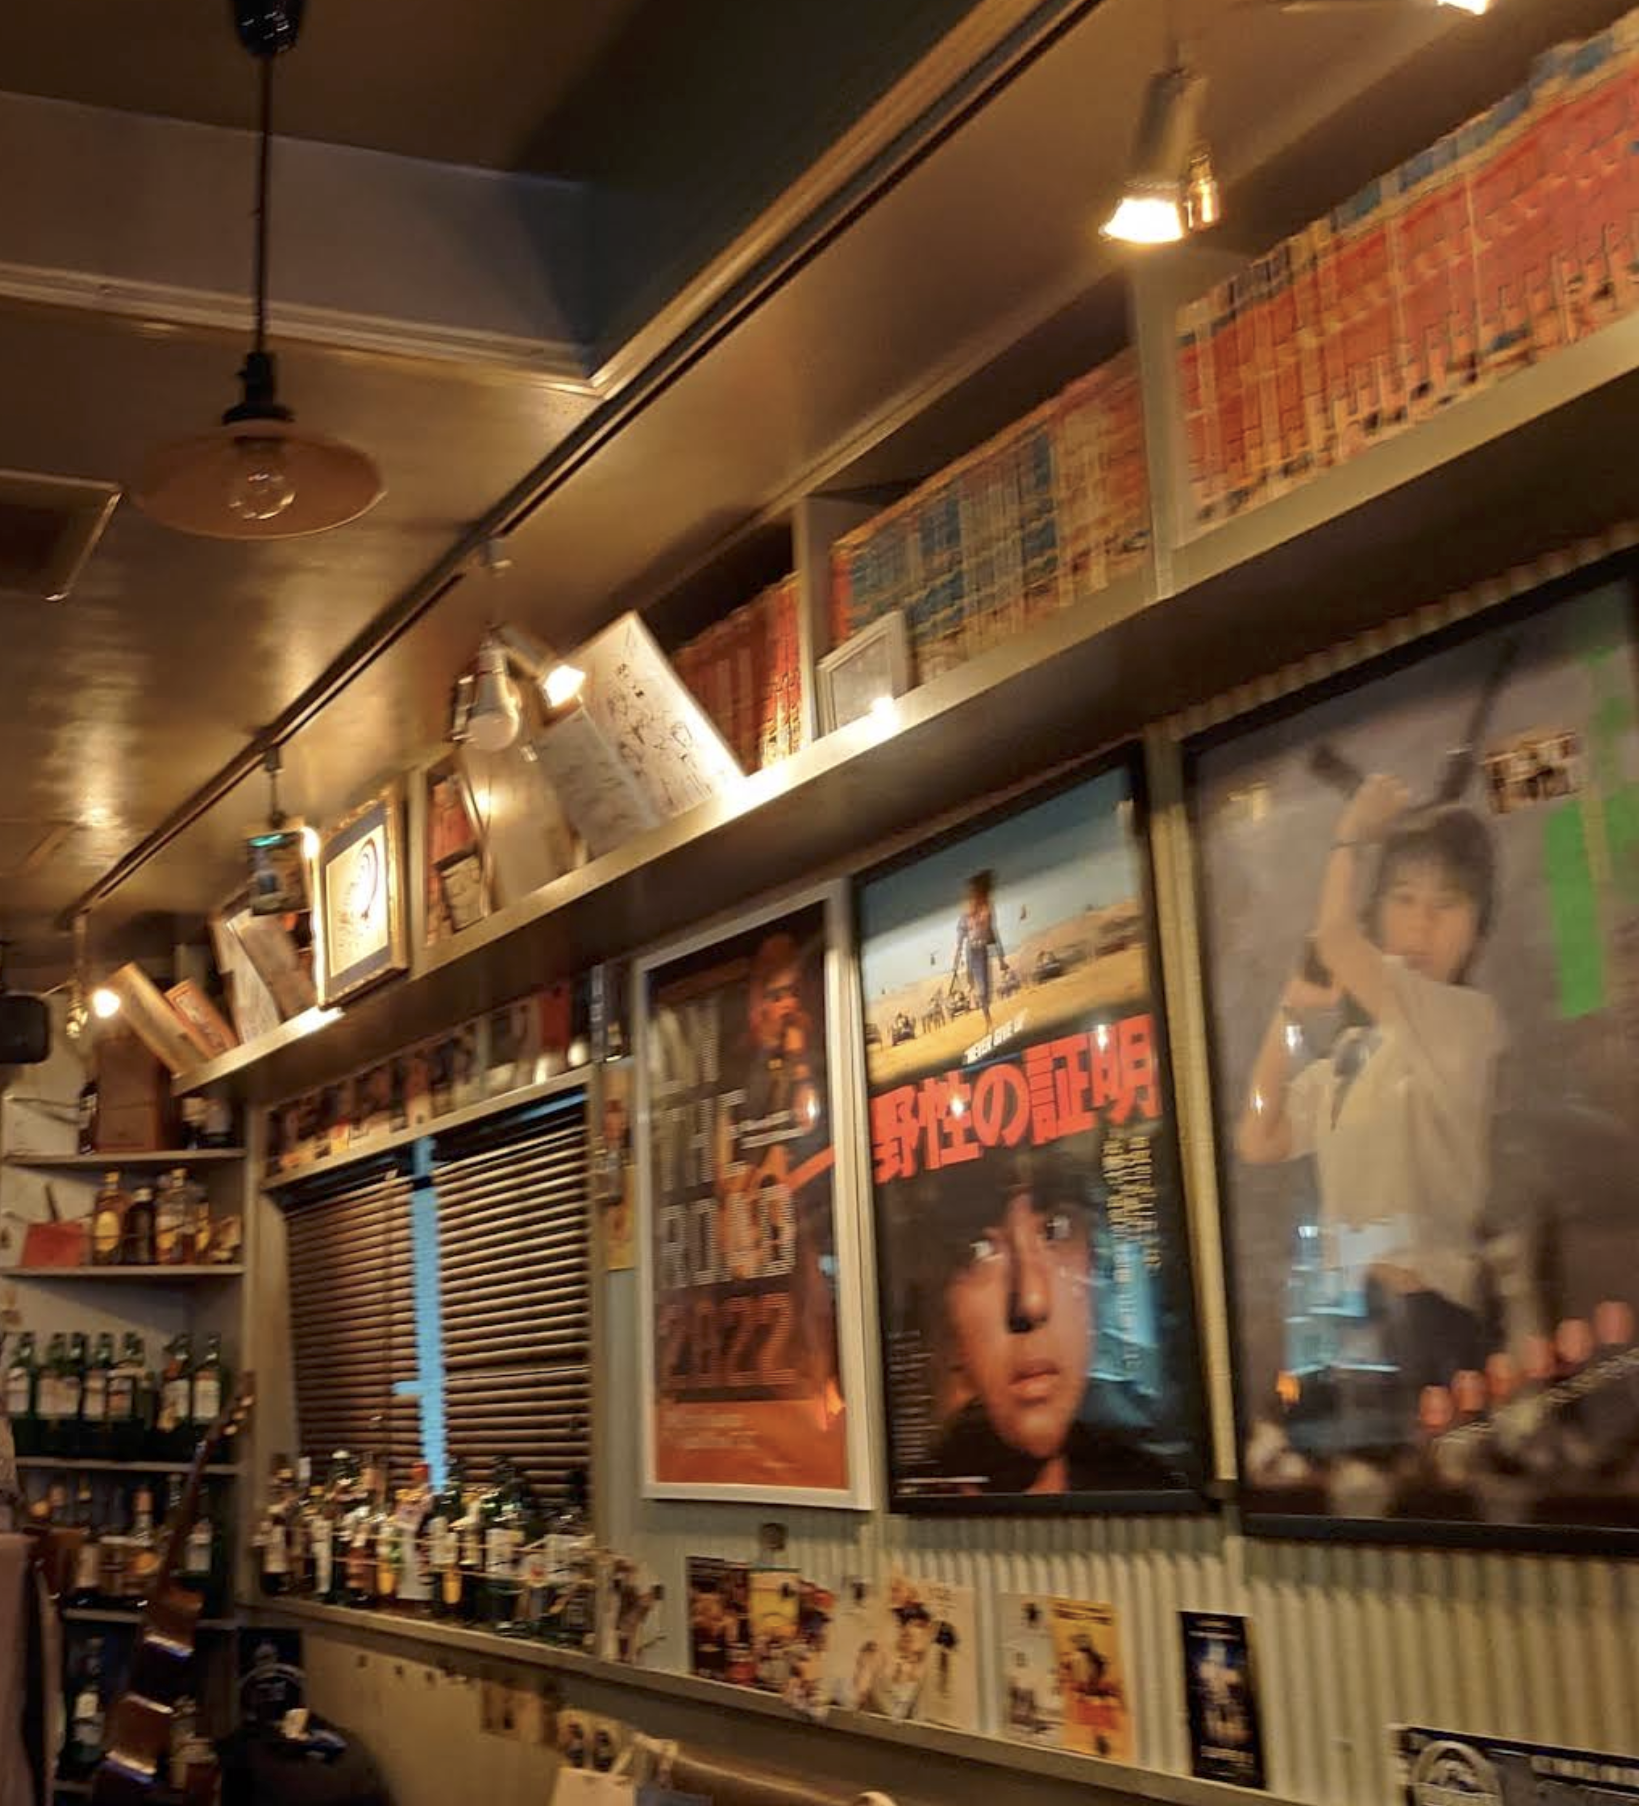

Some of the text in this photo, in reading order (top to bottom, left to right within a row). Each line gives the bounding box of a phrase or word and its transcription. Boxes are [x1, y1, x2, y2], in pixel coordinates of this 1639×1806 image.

[652, 1088, 747, 1193] THE
[870, 1013, 1160, 1186] 野性の証明
